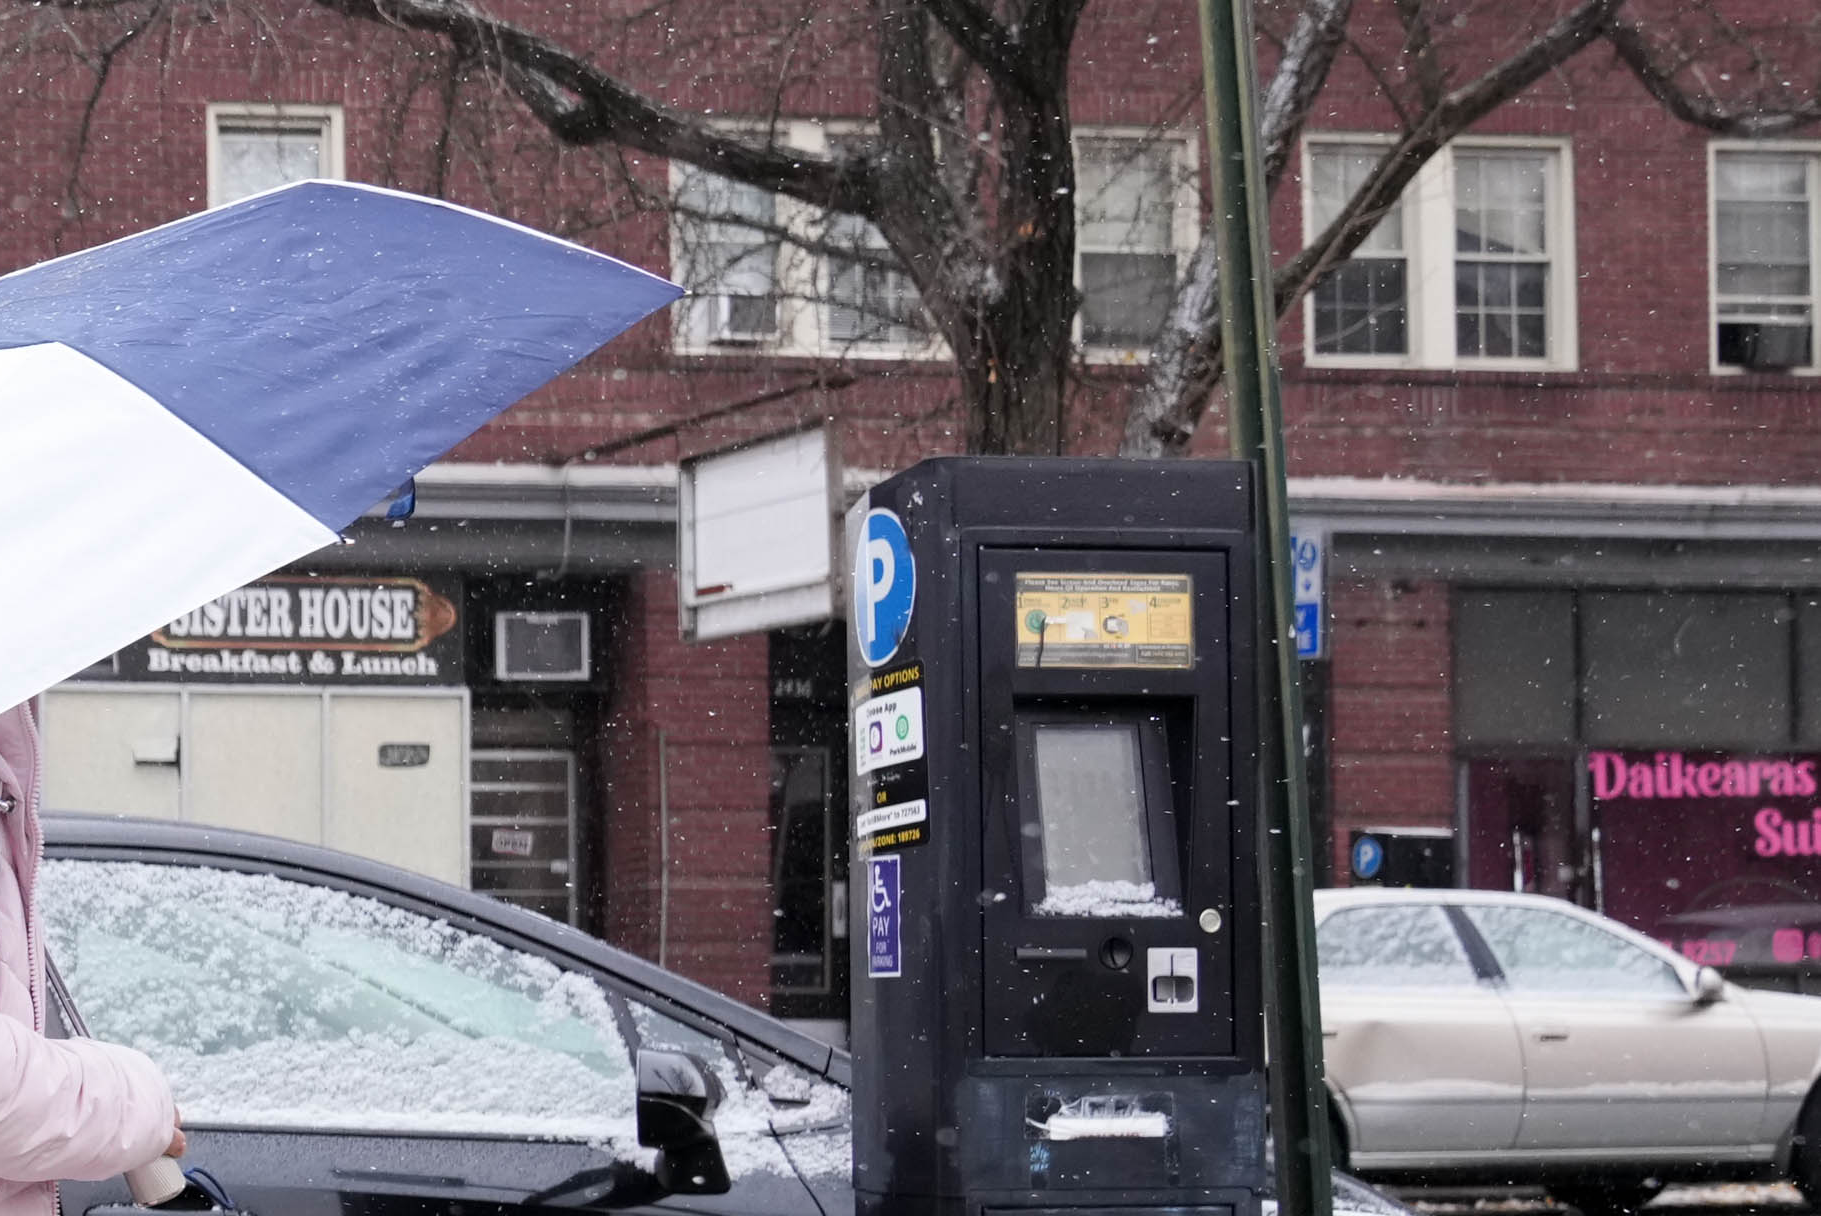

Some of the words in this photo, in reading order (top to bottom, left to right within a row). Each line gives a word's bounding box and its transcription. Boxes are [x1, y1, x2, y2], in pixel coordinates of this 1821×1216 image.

[866, 538, 895, 642] P
[299, 587, 414, 639] HOUSE
[147, 648, 302, 674] Breakfast
[308, 651, 335, 674] &
[341, 651, 438, 676] Lunch
[884, 666, 920, 688] OPTIONS
[884, 702, 897, 715] App
[1588, 751, 1817, 800] Daikearas
[1360, 845, 1374, 871] P
[872, 916, 890, 937] PAY
[875, 941, 887, 954] FOR
